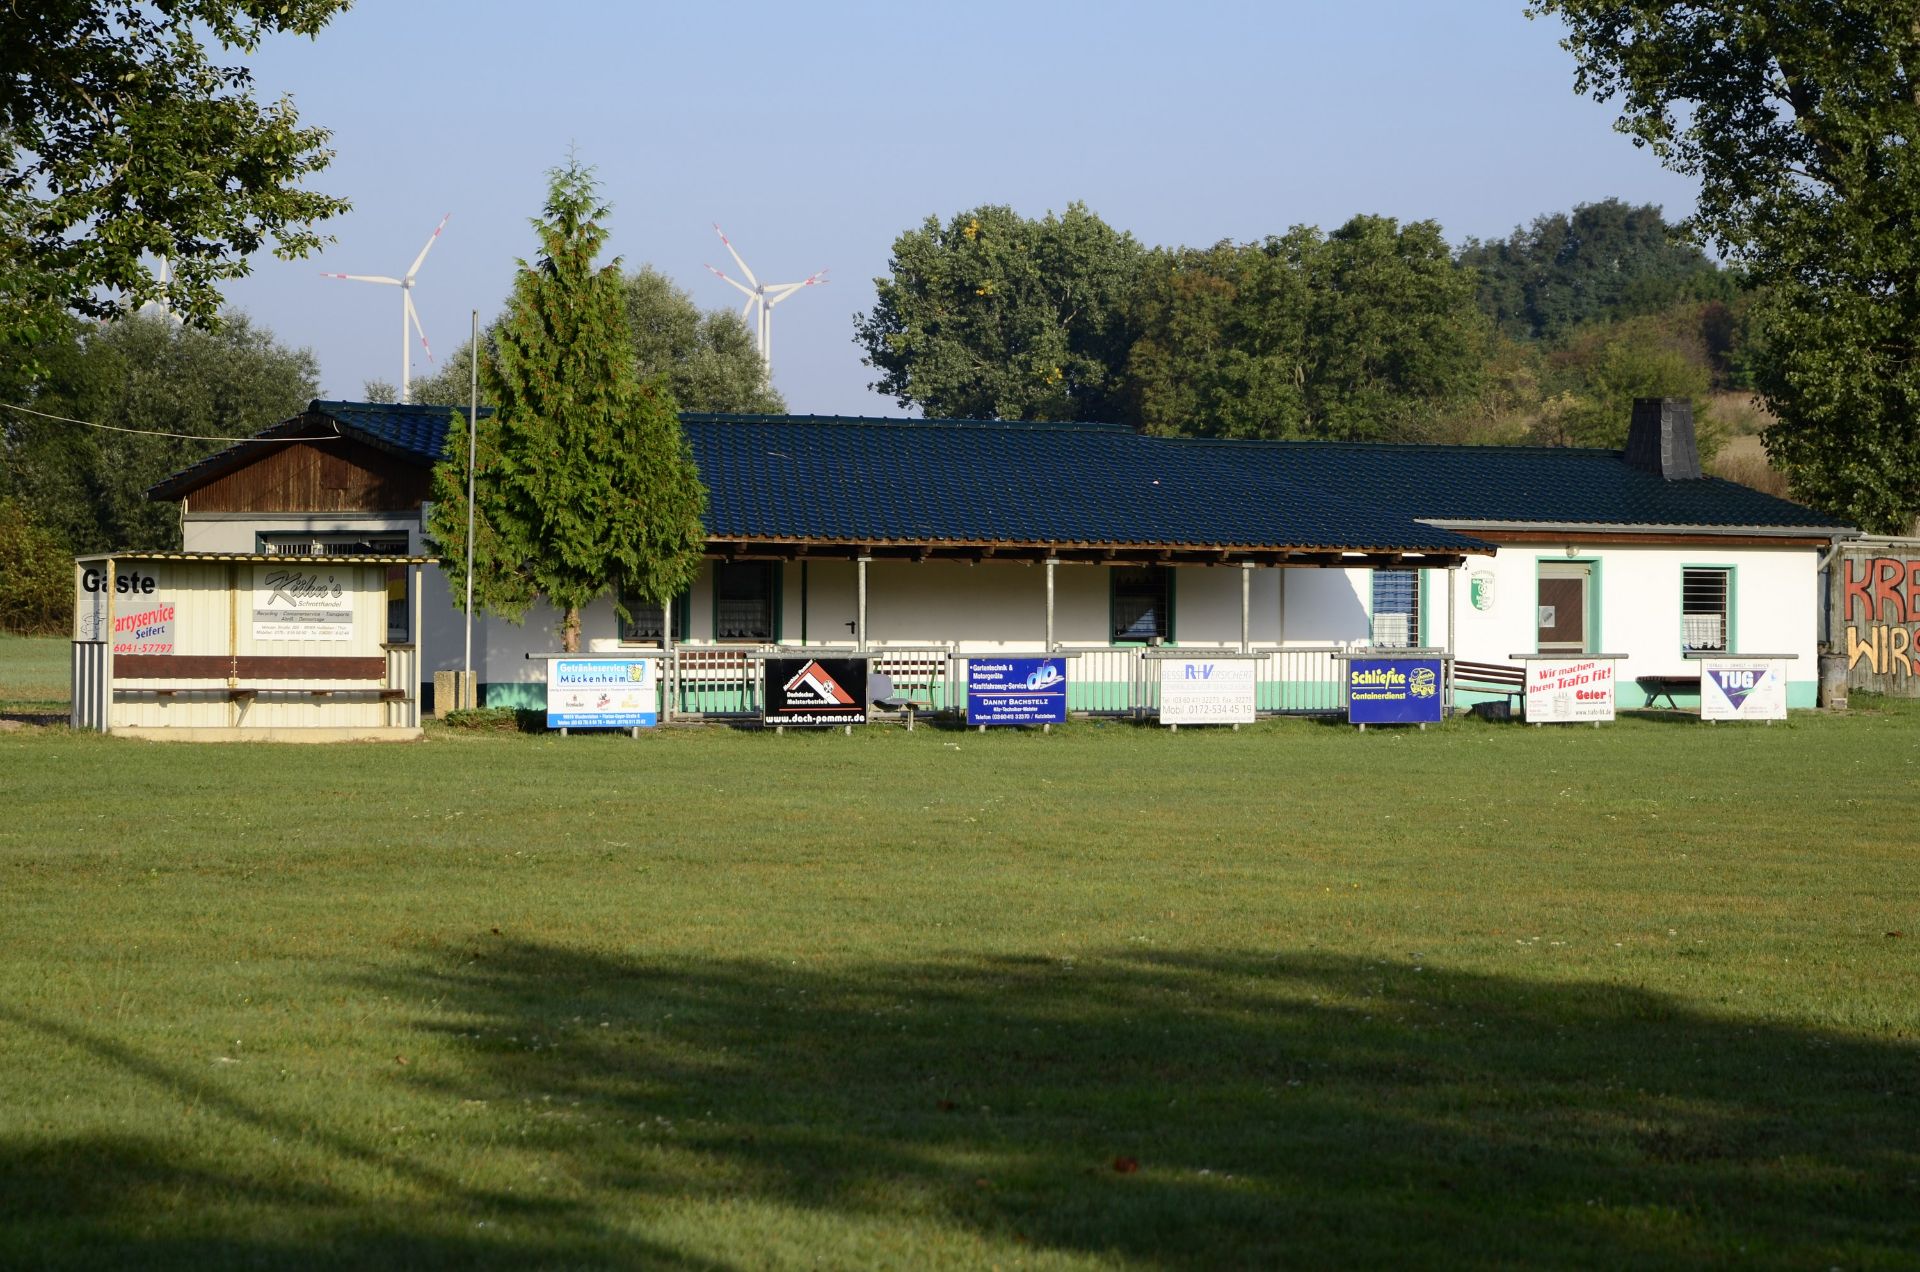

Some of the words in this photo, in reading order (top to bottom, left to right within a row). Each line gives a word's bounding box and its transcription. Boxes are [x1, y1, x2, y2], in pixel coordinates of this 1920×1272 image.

[264, 569, 343, 607] Kühn's
[297, 600, 342, 608] Schrotthandel
[113, 603, 174, 633] artyservice
[135, 625, 165, 640] Seifert
[1846, 624, 1912, 677] WIR
[560, 663, 625, 672] Getränkeservice
[1539, 669, 1557, 680] Wir
[1558, 662, 1595, 676] machen
[560, 674, 626, 683] Mückenheim
[1351, 667, 1406, 690] Schliefke
[1529, 683, 1554, 694] Ihren
[1557, 674, 1589, 689] Trafo
[1592, 667, 1611, 682] fit!
[1718, 670, 1754, 689] TUG
[1351, 692, 1406, 700] Containerdienst
[1188, 704, 1227, 714] 0172-534
[1229, 704, 1239, 713] 45
[1242, 704, 1252, 713] 19
[765, 713, 866, 725] www.dach-pommer.de
